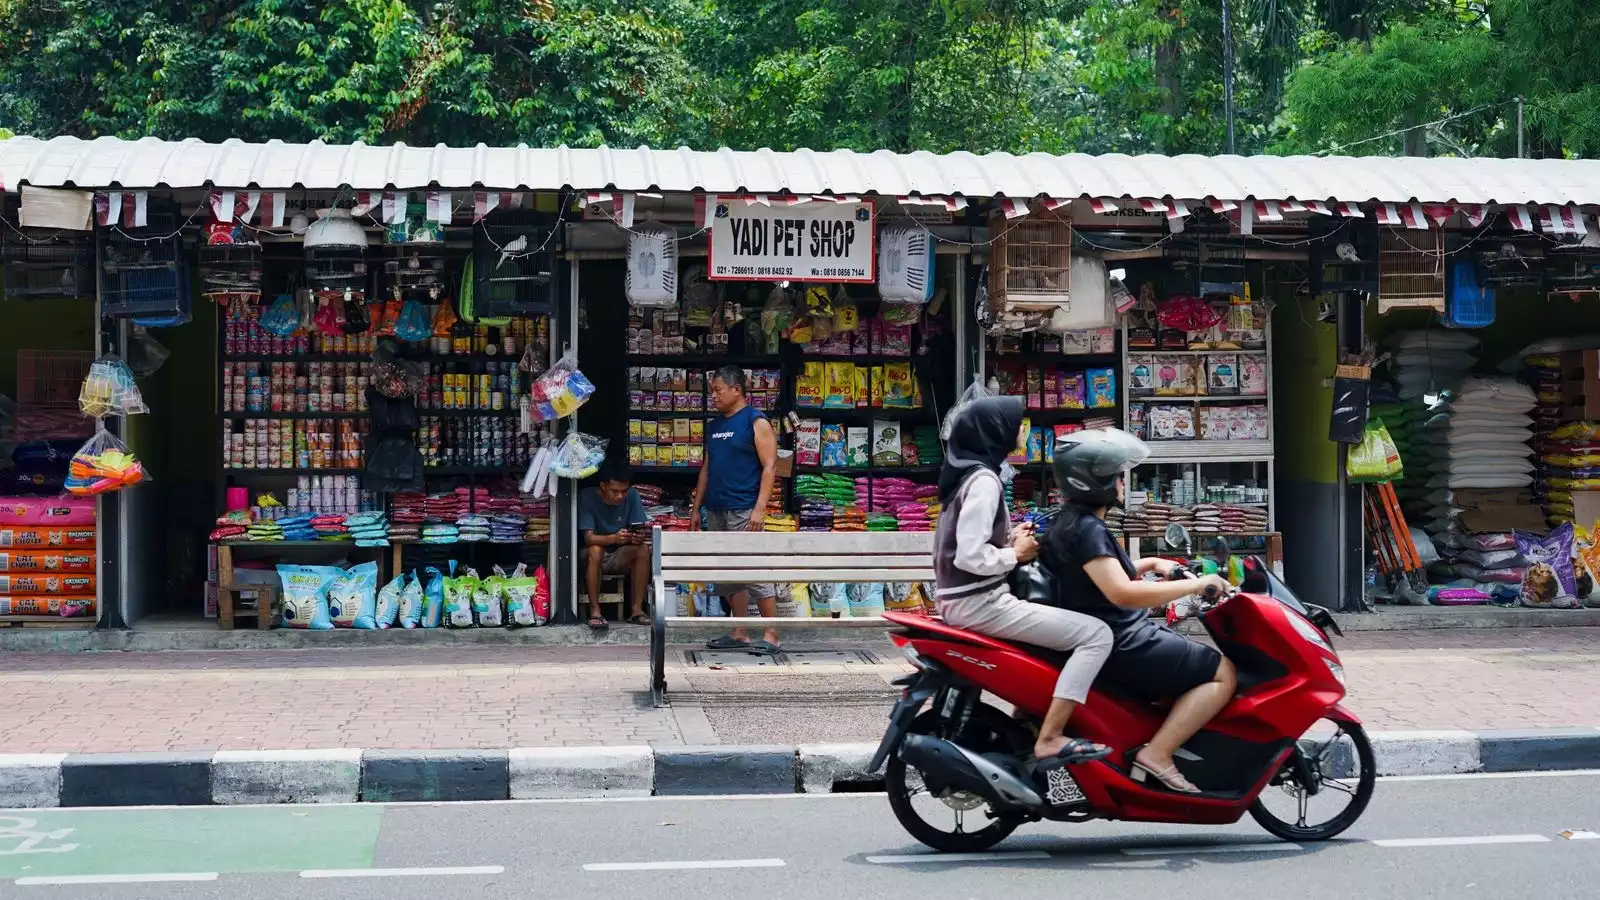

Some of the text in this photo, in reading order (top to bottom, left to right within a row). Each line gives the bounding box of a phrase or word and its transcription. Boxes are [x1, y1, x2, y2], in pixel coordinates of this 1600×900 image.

[730, 217, 855, 258] YADI PET SHOP
[716, 266, 727, 274] 021
[757, 267, 771, 275] 0818
[810, 268, 819, 276] Wa
[823, 268, 837, 276] 0818
[837, 268, 851, 276] 0856
[851, 268, 865, 277] 7144
[888, 371, 907, 381] Me-O
[799, 385, 821, 395] Me-O
[830, 385, 851, 395] Me-O
[945, 649, 999, 671] PCX
